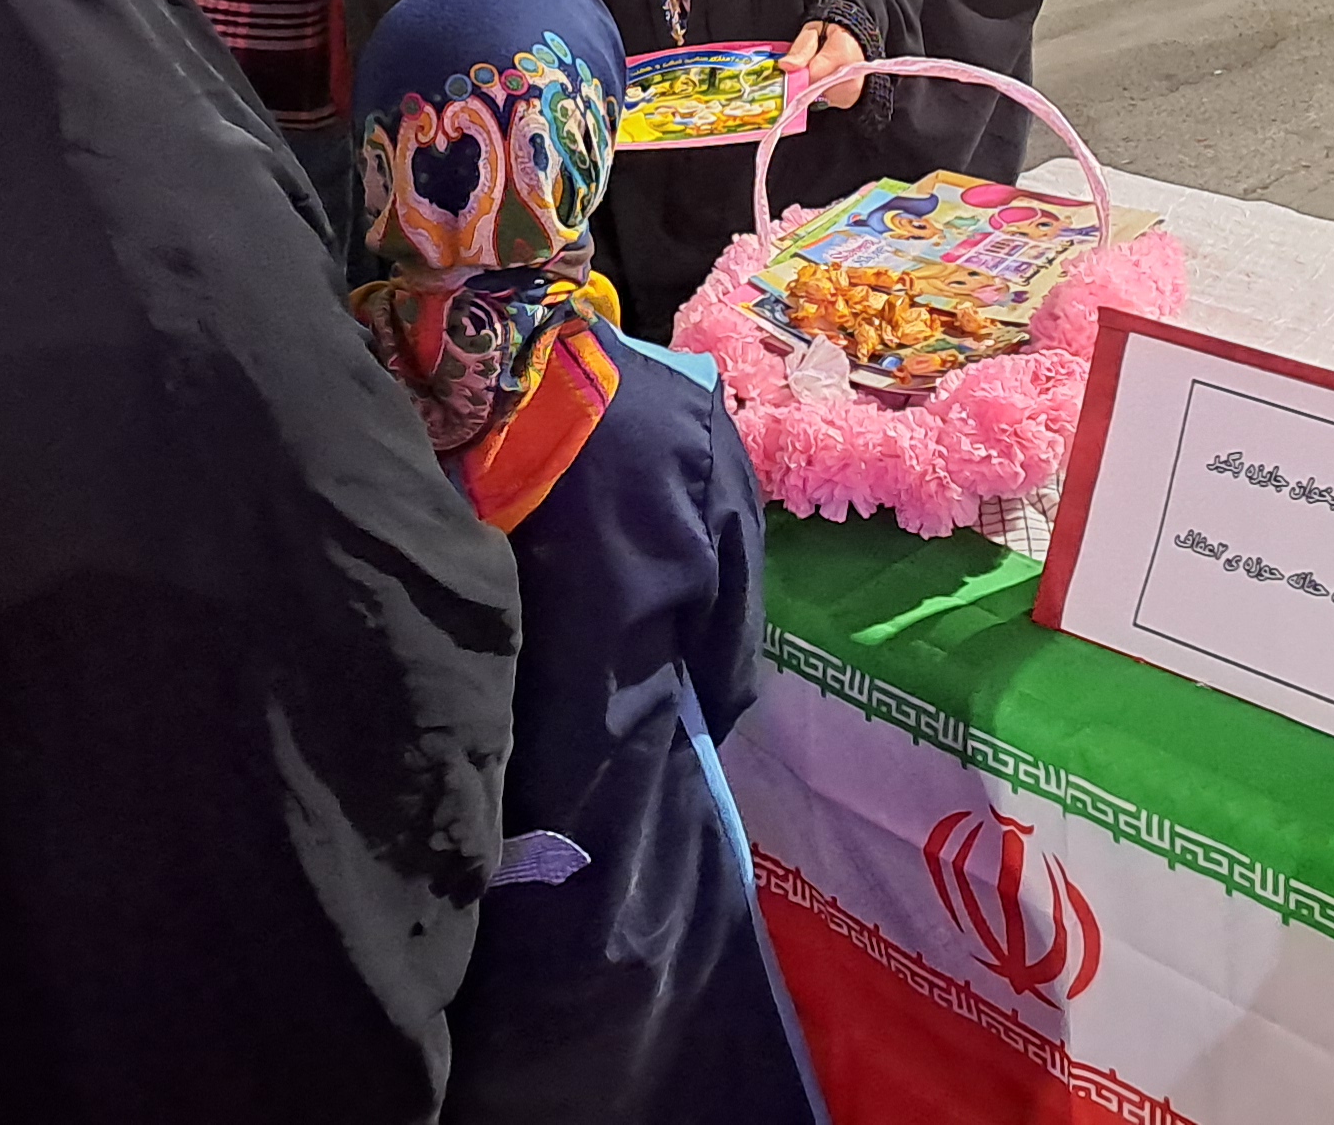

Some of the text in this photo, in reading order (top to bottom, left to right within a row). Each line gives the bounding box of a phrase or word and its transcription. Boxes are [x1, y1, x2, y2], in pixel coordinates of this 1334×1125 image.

[1206, 451, 1244, 478] بگیر
[1245, 464, 1289, 493] جایزه
[1223, 555, 1242, 571] ی
[1243, 557, 1285, 581] حوزه
